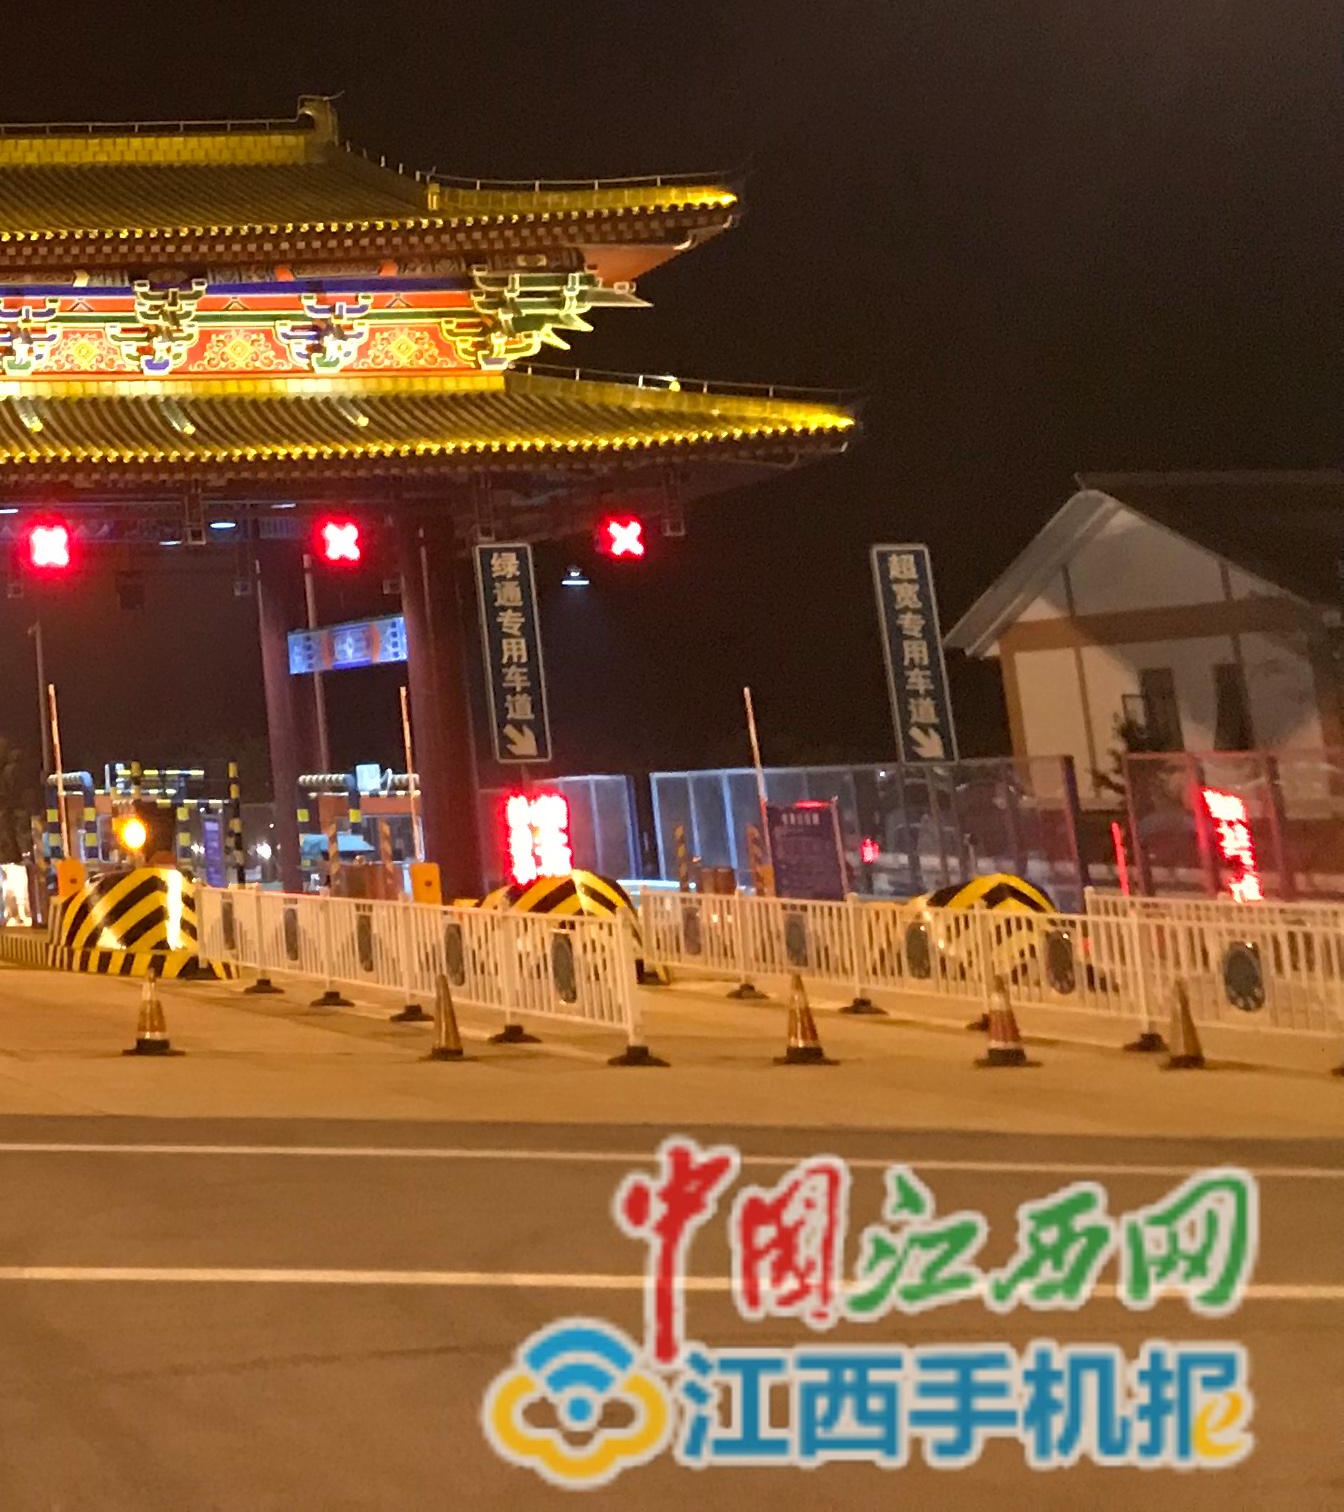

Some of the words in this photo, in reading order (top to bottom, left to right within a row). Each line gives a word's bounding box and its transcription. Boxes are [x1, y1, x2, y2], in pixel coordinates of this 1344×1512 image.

[490, 551, 535, 720] 绿通专用车道
[887, 552, 940, 724] 超宽专用车道
